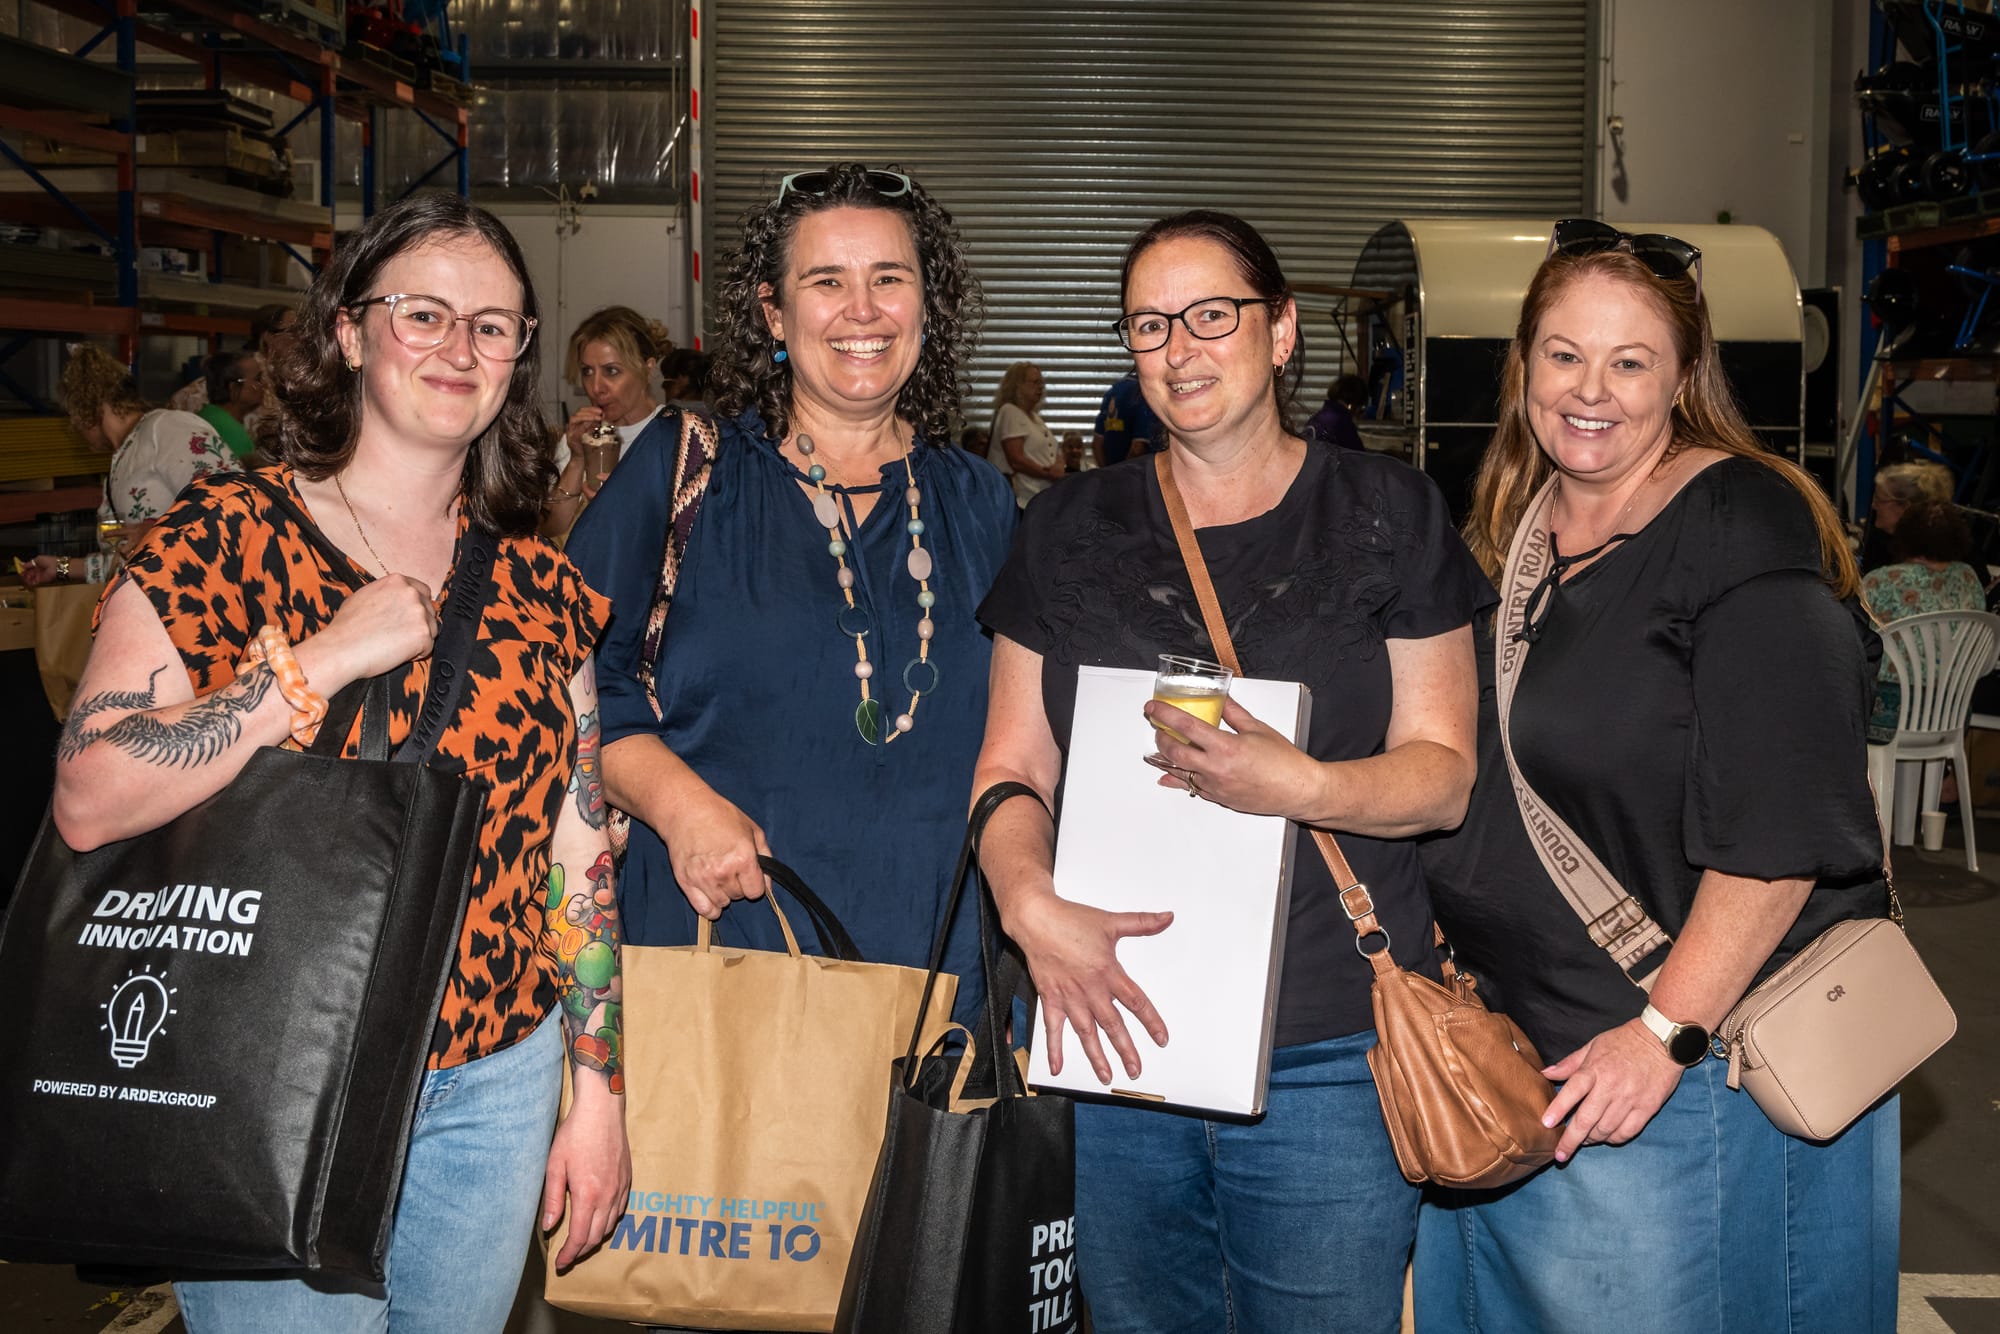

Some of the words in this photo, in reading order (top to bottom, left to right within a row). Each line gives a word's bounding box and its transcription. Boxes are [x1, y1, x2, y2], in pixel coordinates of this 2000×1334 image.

[1502, 581, 1533, 675] COUNTRY
[1519, 528, 1547, 578] ROAD
[1515, 786, 1580, 875] COUNTRY
[92, 884, 263, 924] DRIVING
[78, 923, 253, 956] INNOVATION
[1826, 984, 1846, 1002] CR
[33, 1079, 96, 1097] POWERED
[99, 1085, 118, 1099] BY
[118, 1087, 216, 1108] ARDEXGROUP
[609, 1214, 752, 1260] MITRE
[768, 1224, 821, 1262] 10
